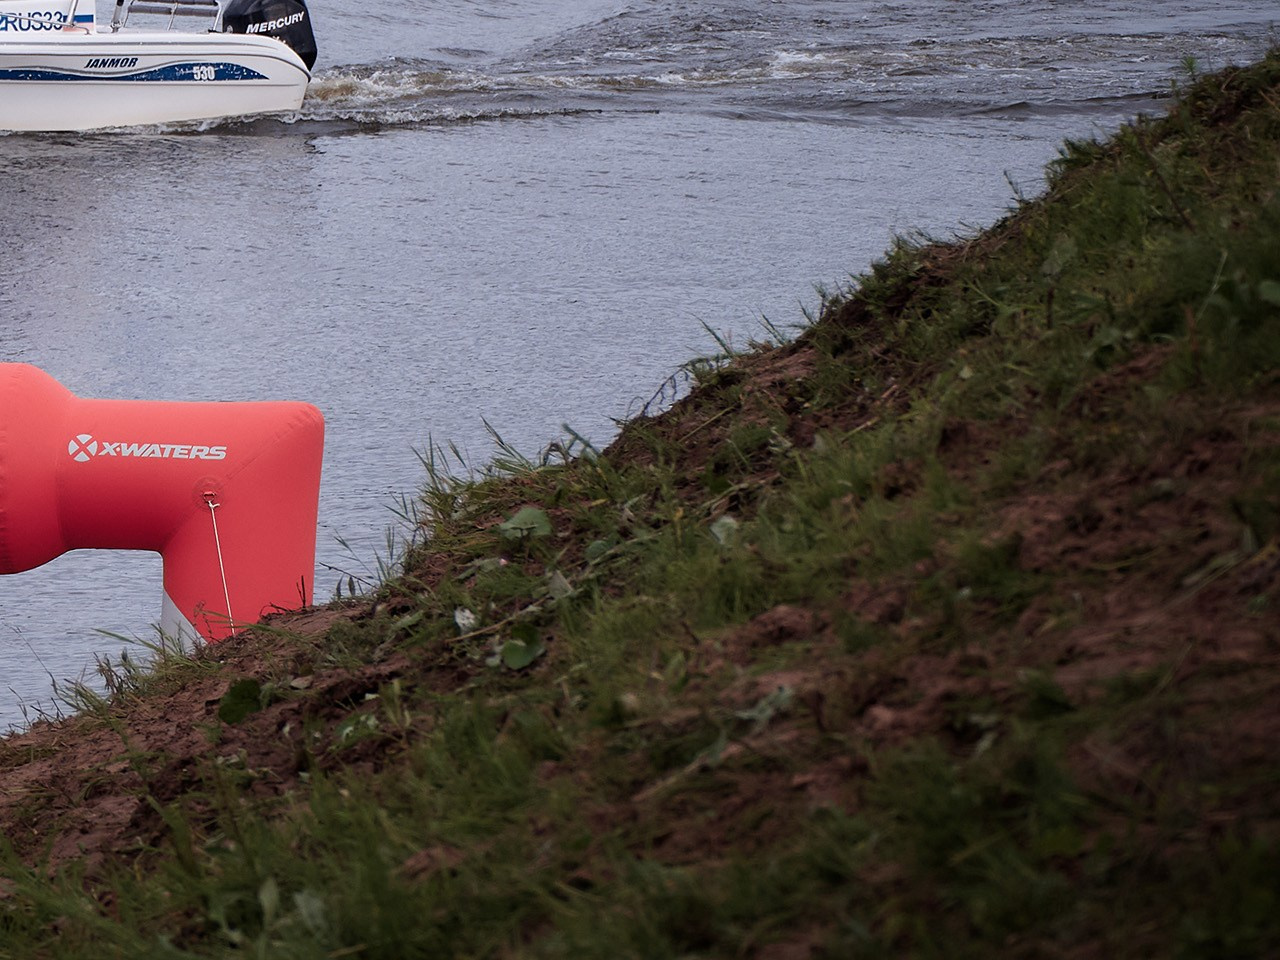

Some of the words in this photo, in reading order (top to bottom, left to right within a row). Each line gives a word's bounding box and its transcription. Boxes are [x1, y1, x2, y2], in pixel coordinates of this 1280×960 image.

[245, 11, 305, 34] MERCURY
[84, 58, 139, 69] JANMOR
[192, 66, 216, 81] 530
